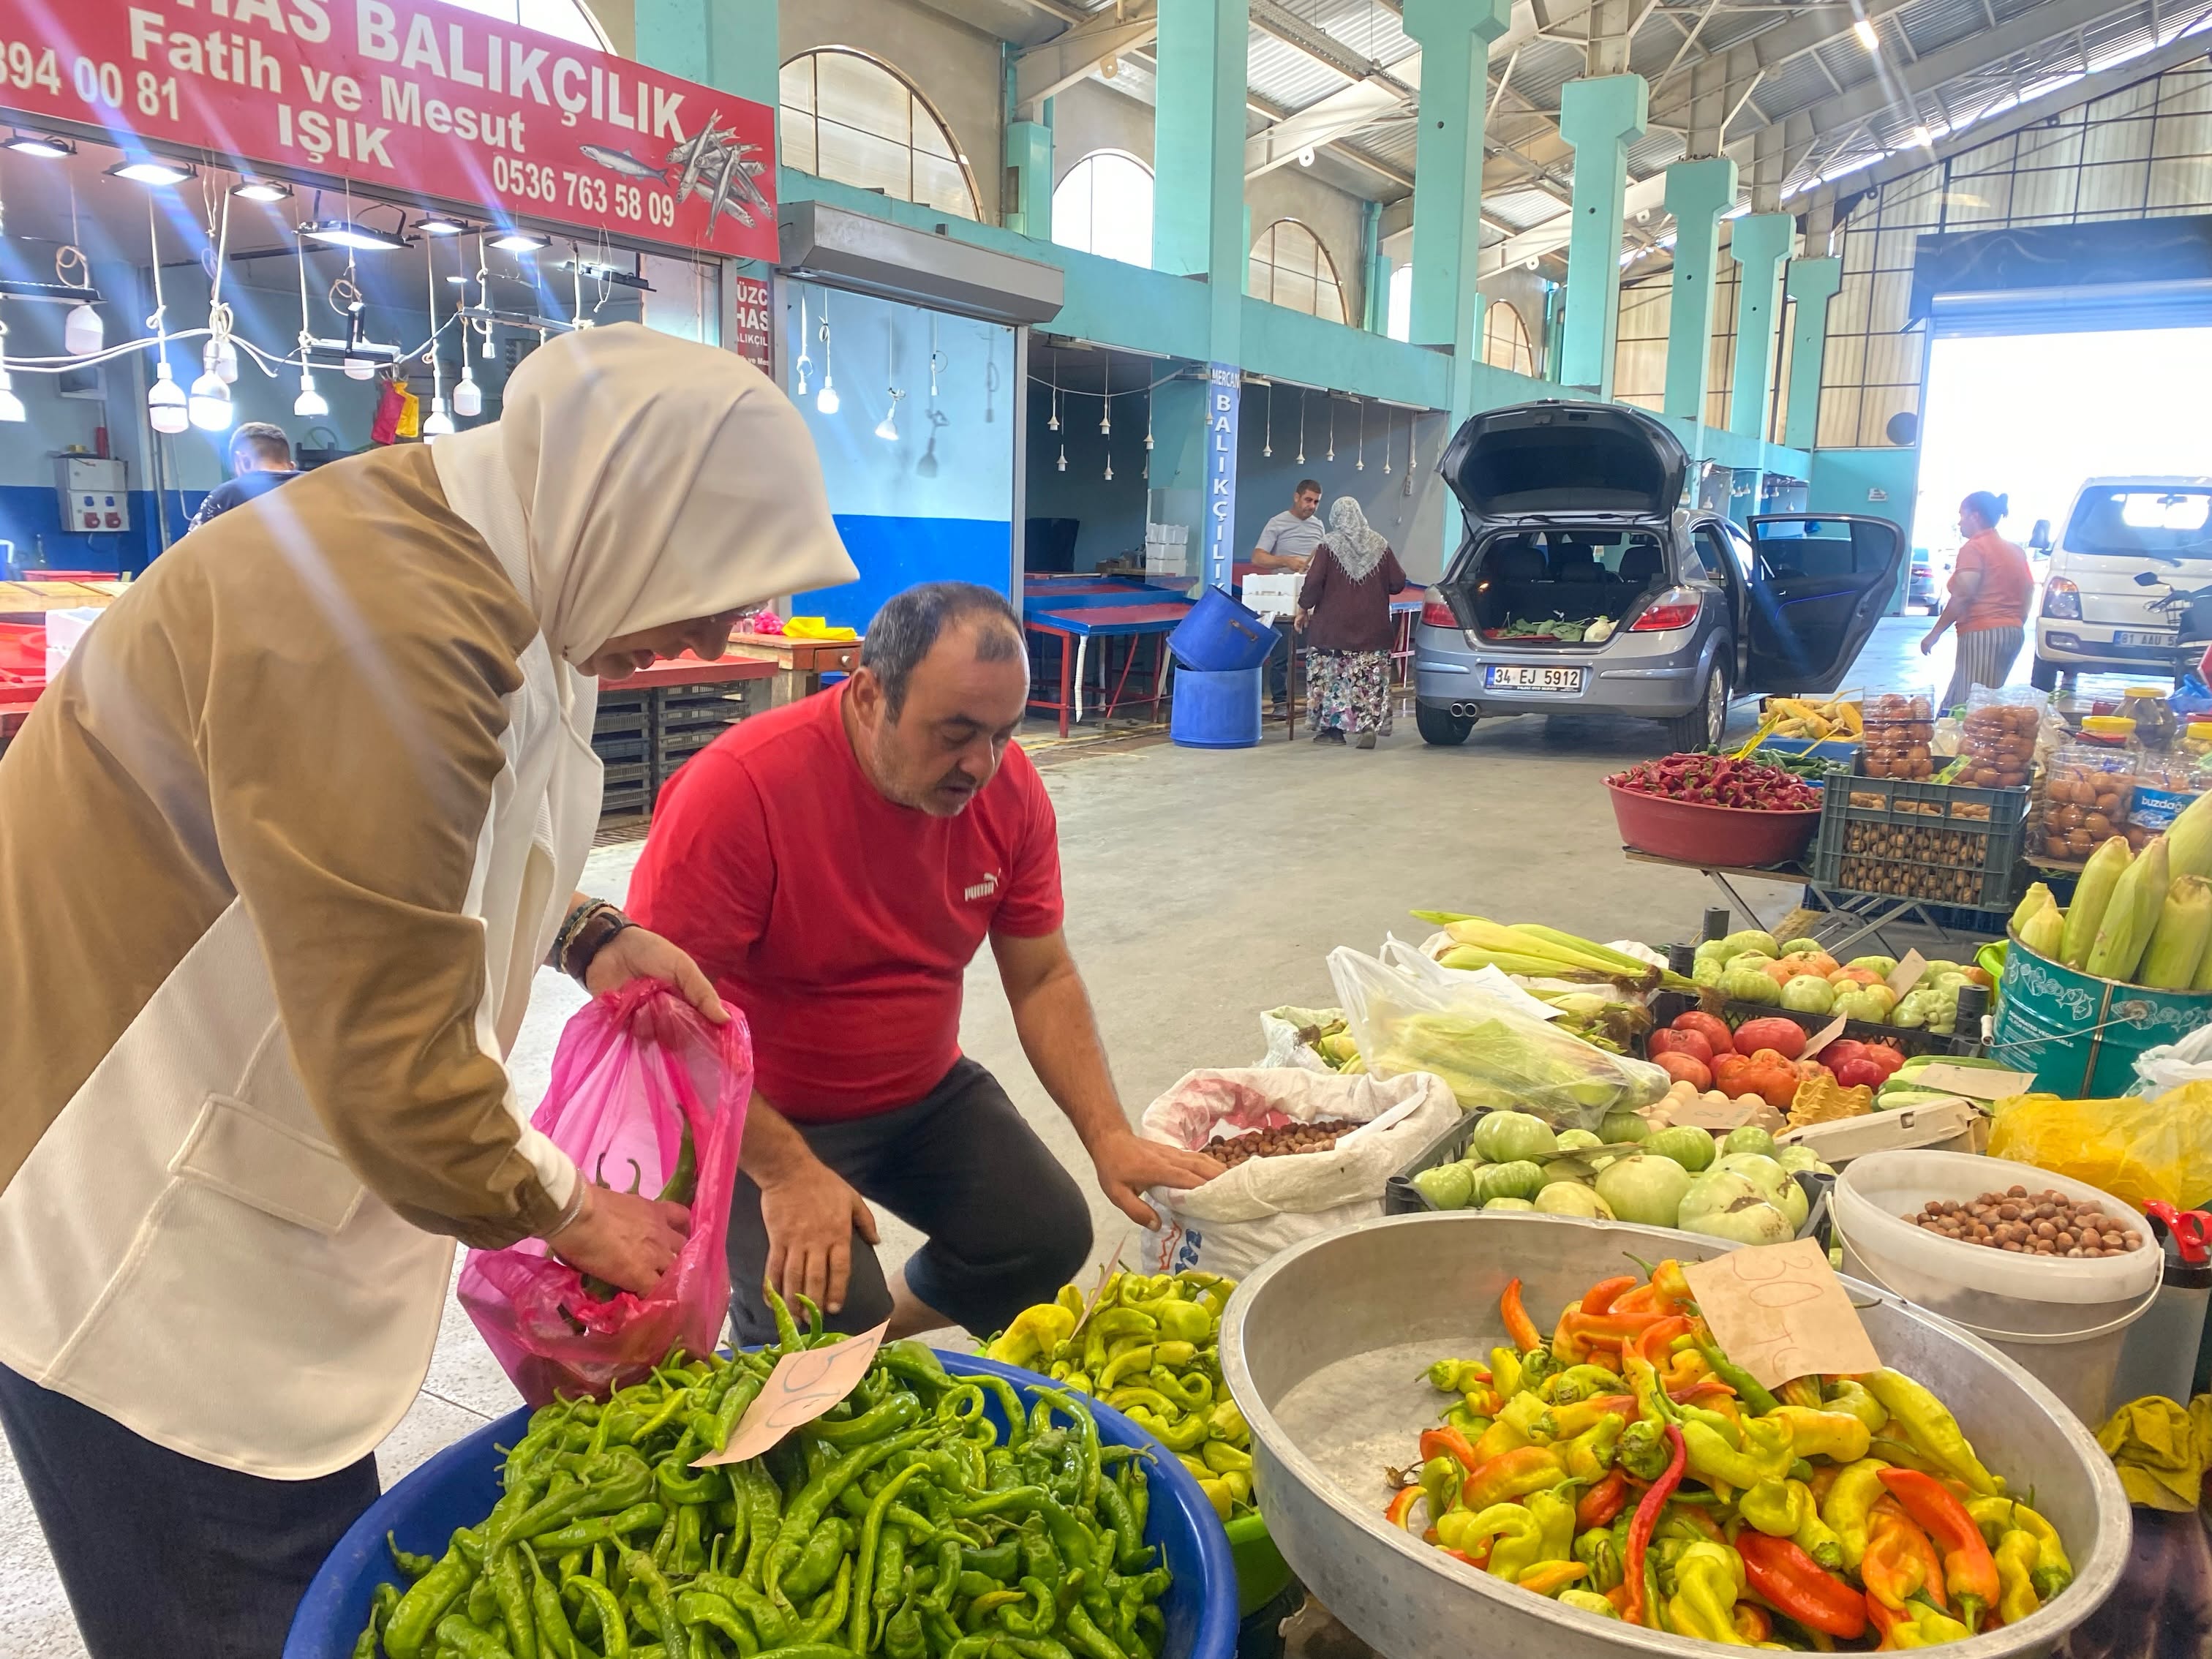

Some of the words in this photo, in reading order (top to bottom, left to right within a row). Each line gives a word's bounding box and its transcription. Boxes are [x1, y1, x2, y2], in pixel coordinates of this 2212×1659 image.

[75, 56, 124, 109] 00
[137, 69, 179, 121] 81
[129, 7, 282, 94] Fatih
[299, 64, 362, 111] ve
[380, 74, 526, 154] Mesut
[176, 0, 331, 43] AS
[356, 0, 686, 144] BALIKÇILIK
[278, 103, 396, 169] IŞIK
[492, 156, 557, 203] 0536
[563, 171, 607, 214] 763
[615, 187, 642, 225] 58
[649, 194, 674, 228] 09
[737, 333, 768, 348] LIKÇIL
[1211, 368, 1240, 388] MERCAN
[1211, 394, 1231, 589] BALIKÇILI
[1495, 669, 1511, 684] 34
[1519, 669, 1536, 684] EJ
[1544, 670, 1579, 686] 5912
[964, 881, 994, 902] PUMA
